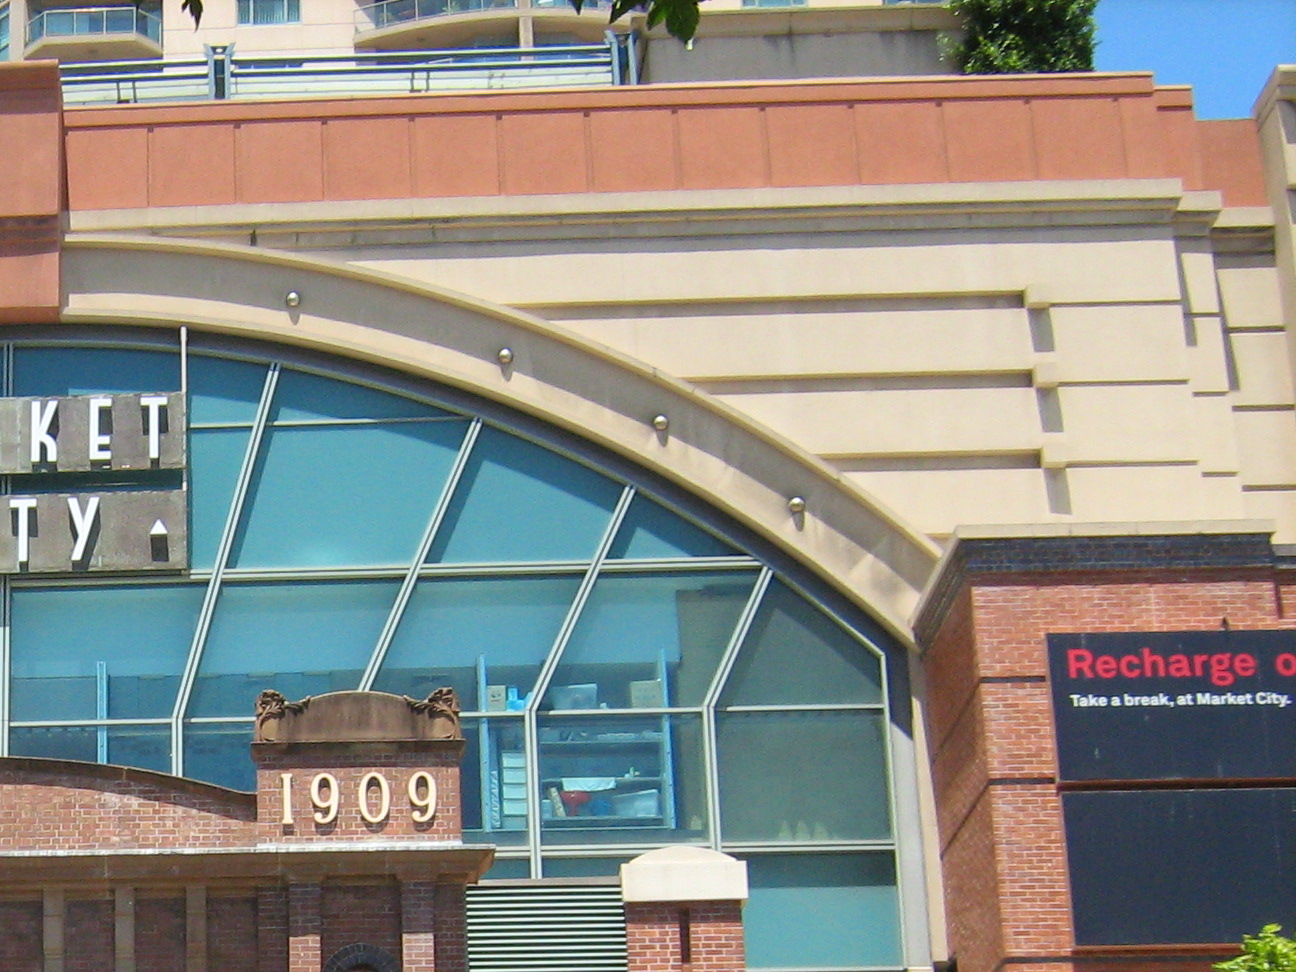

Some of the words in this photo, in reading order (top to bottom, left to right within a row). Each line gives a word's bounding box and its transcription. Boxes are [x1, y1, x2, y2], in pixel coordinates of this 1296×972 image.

[1066, 647, 1257, 687] Recharge
[1069, 694, 1108, 708] Take
[1110, 697, 1122, 707] a
[1124, 693, 1175, 708] break,
[1176, 694, 1195, 707] at
[1197, 692, 1254, 706] Market
[1255, 692, 1292, 708] City.
[280, 771, 438, 825] 1909
